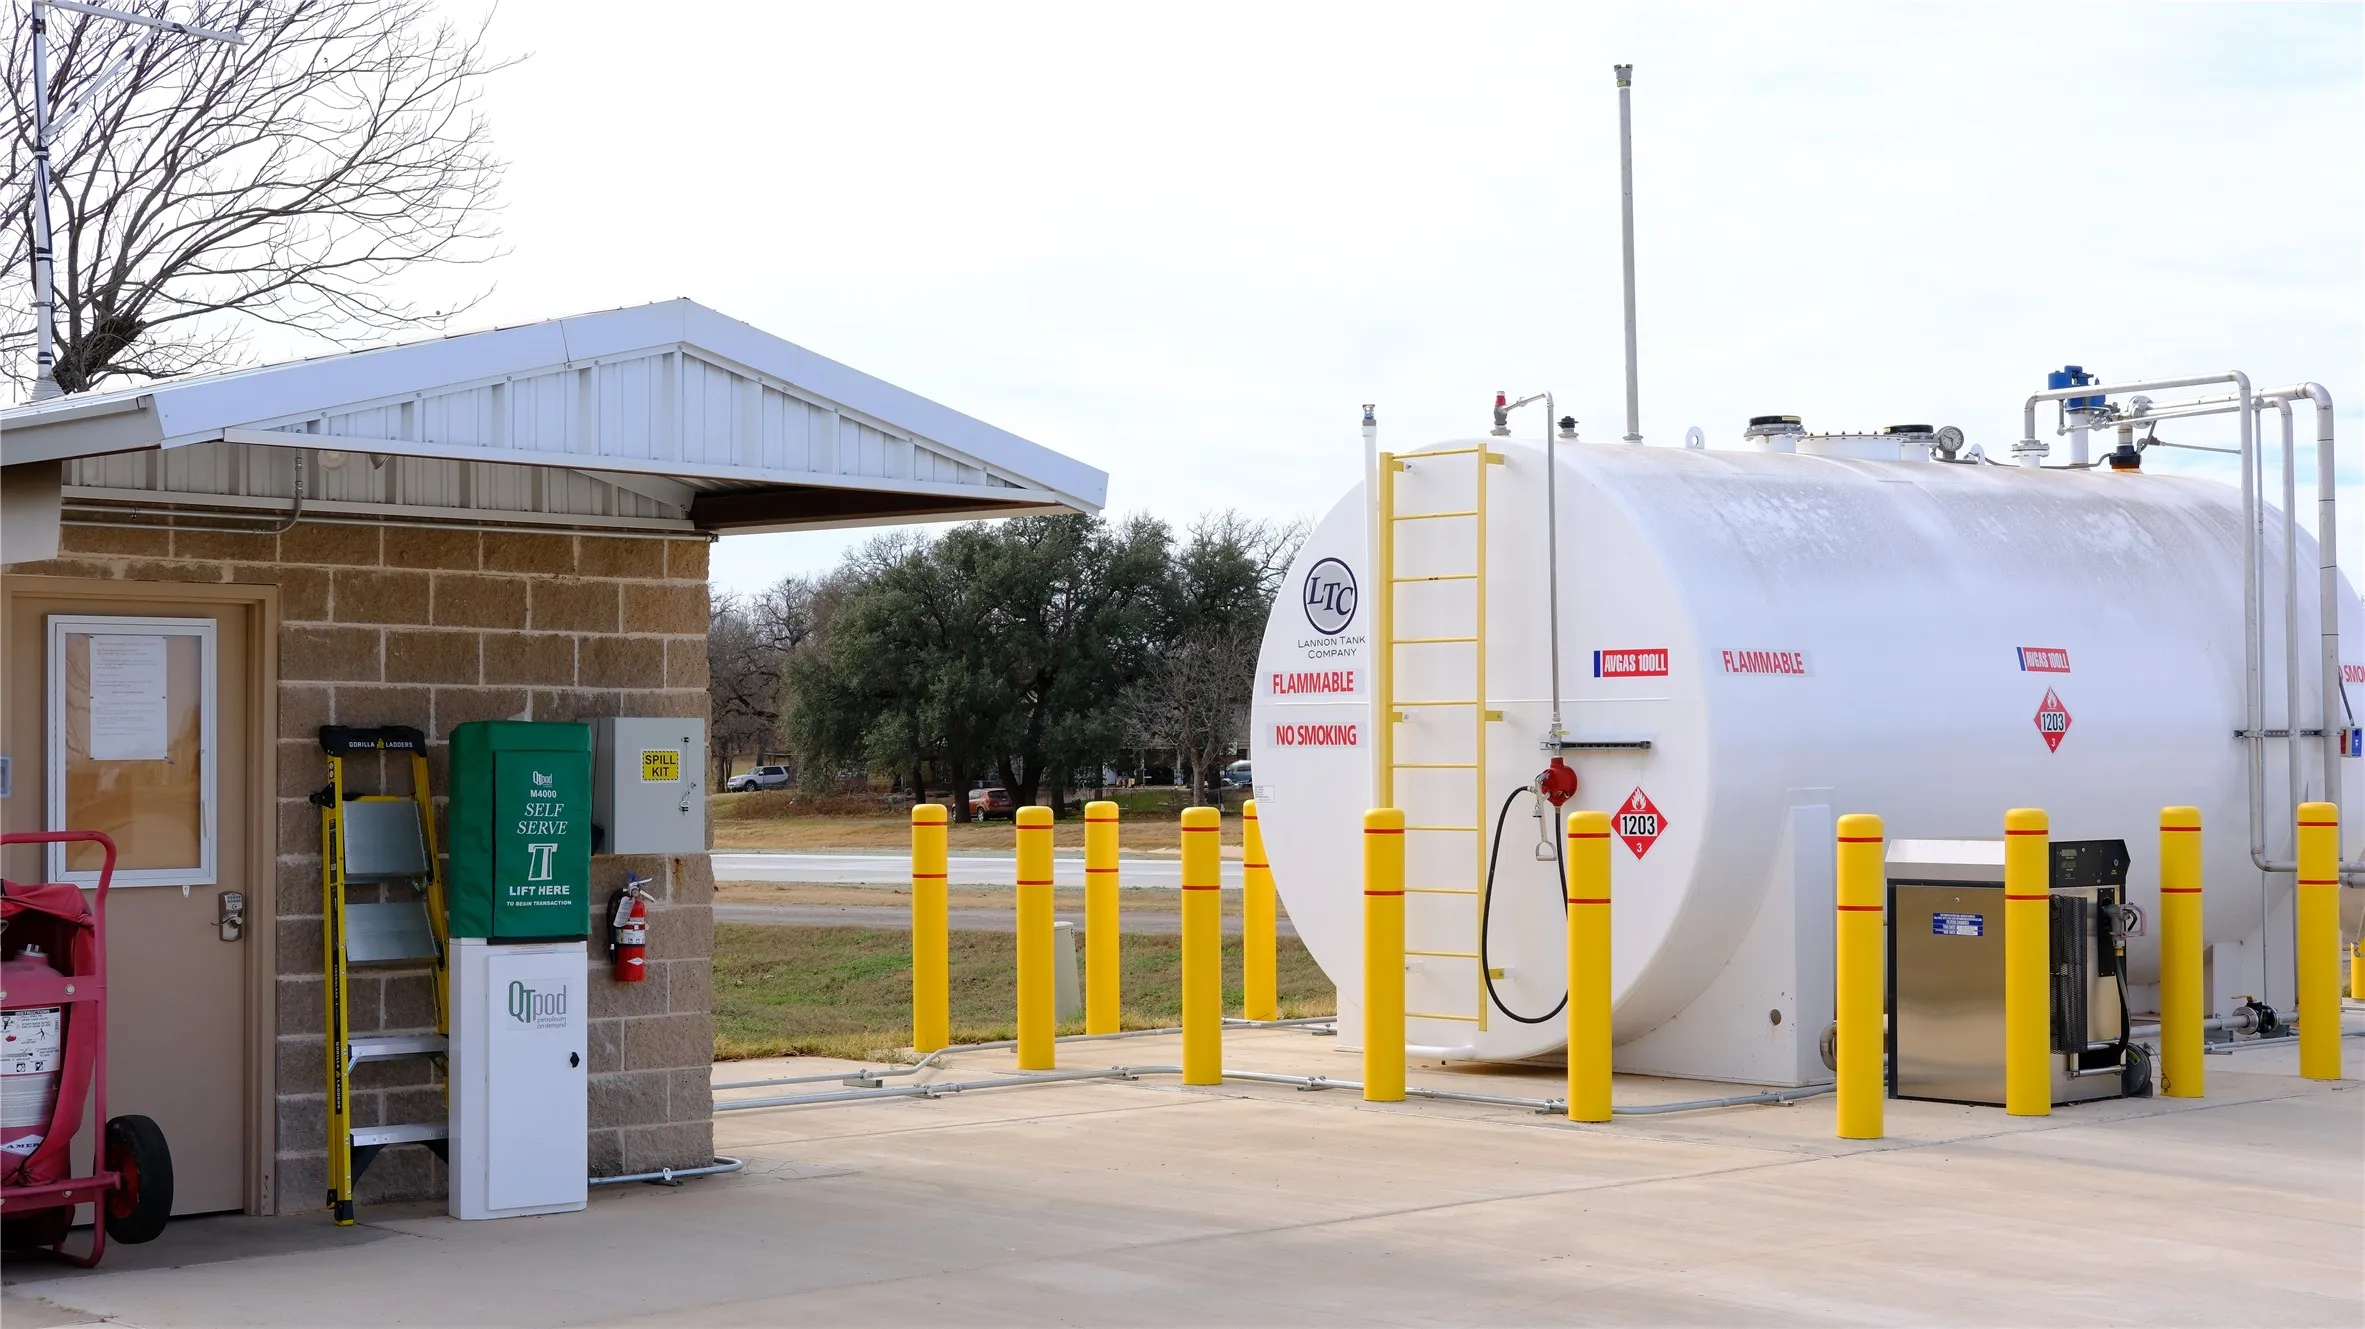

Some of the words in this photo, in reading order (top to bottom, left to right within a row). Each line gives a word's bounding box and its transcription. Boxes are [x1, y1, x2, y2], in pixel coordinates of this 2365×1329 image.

[1307, 576, 1354, 616] LTC
[1297, 638, 1338, 649] LANNON
[1339, 636, 1366, 646] TANK
[1307, 648, 1357, 659] COMPANY
[1604, 654, 1636, 673] AVGAS
[1638, 653, 1667, 672] 100LL
[1722, 650, 1805, 674] FLAMMABLE
[1272, 670, 1355, 695] FLAMMABLE
[2041, 713, 2064, 731] 1203
[1275, 725, 1295, 746] NO
[1297, 724, 1357, 746] SMOKING
[2051, 738, 2056, 747] 3
[645, 754, 676, 765] SPILL
[651, 767, 670, 777] KIT
[530, 789, 557, 798] M4000
[524, 802, 565, 817] SELF
[516, 821, 568, 835] SERVE
[1622, 815, 1655, 835] 1203
[1636, 842, 1643, 853] 3
[509, 886, 536, 896] LIFT
[538, 885, 570, 896] HERE
